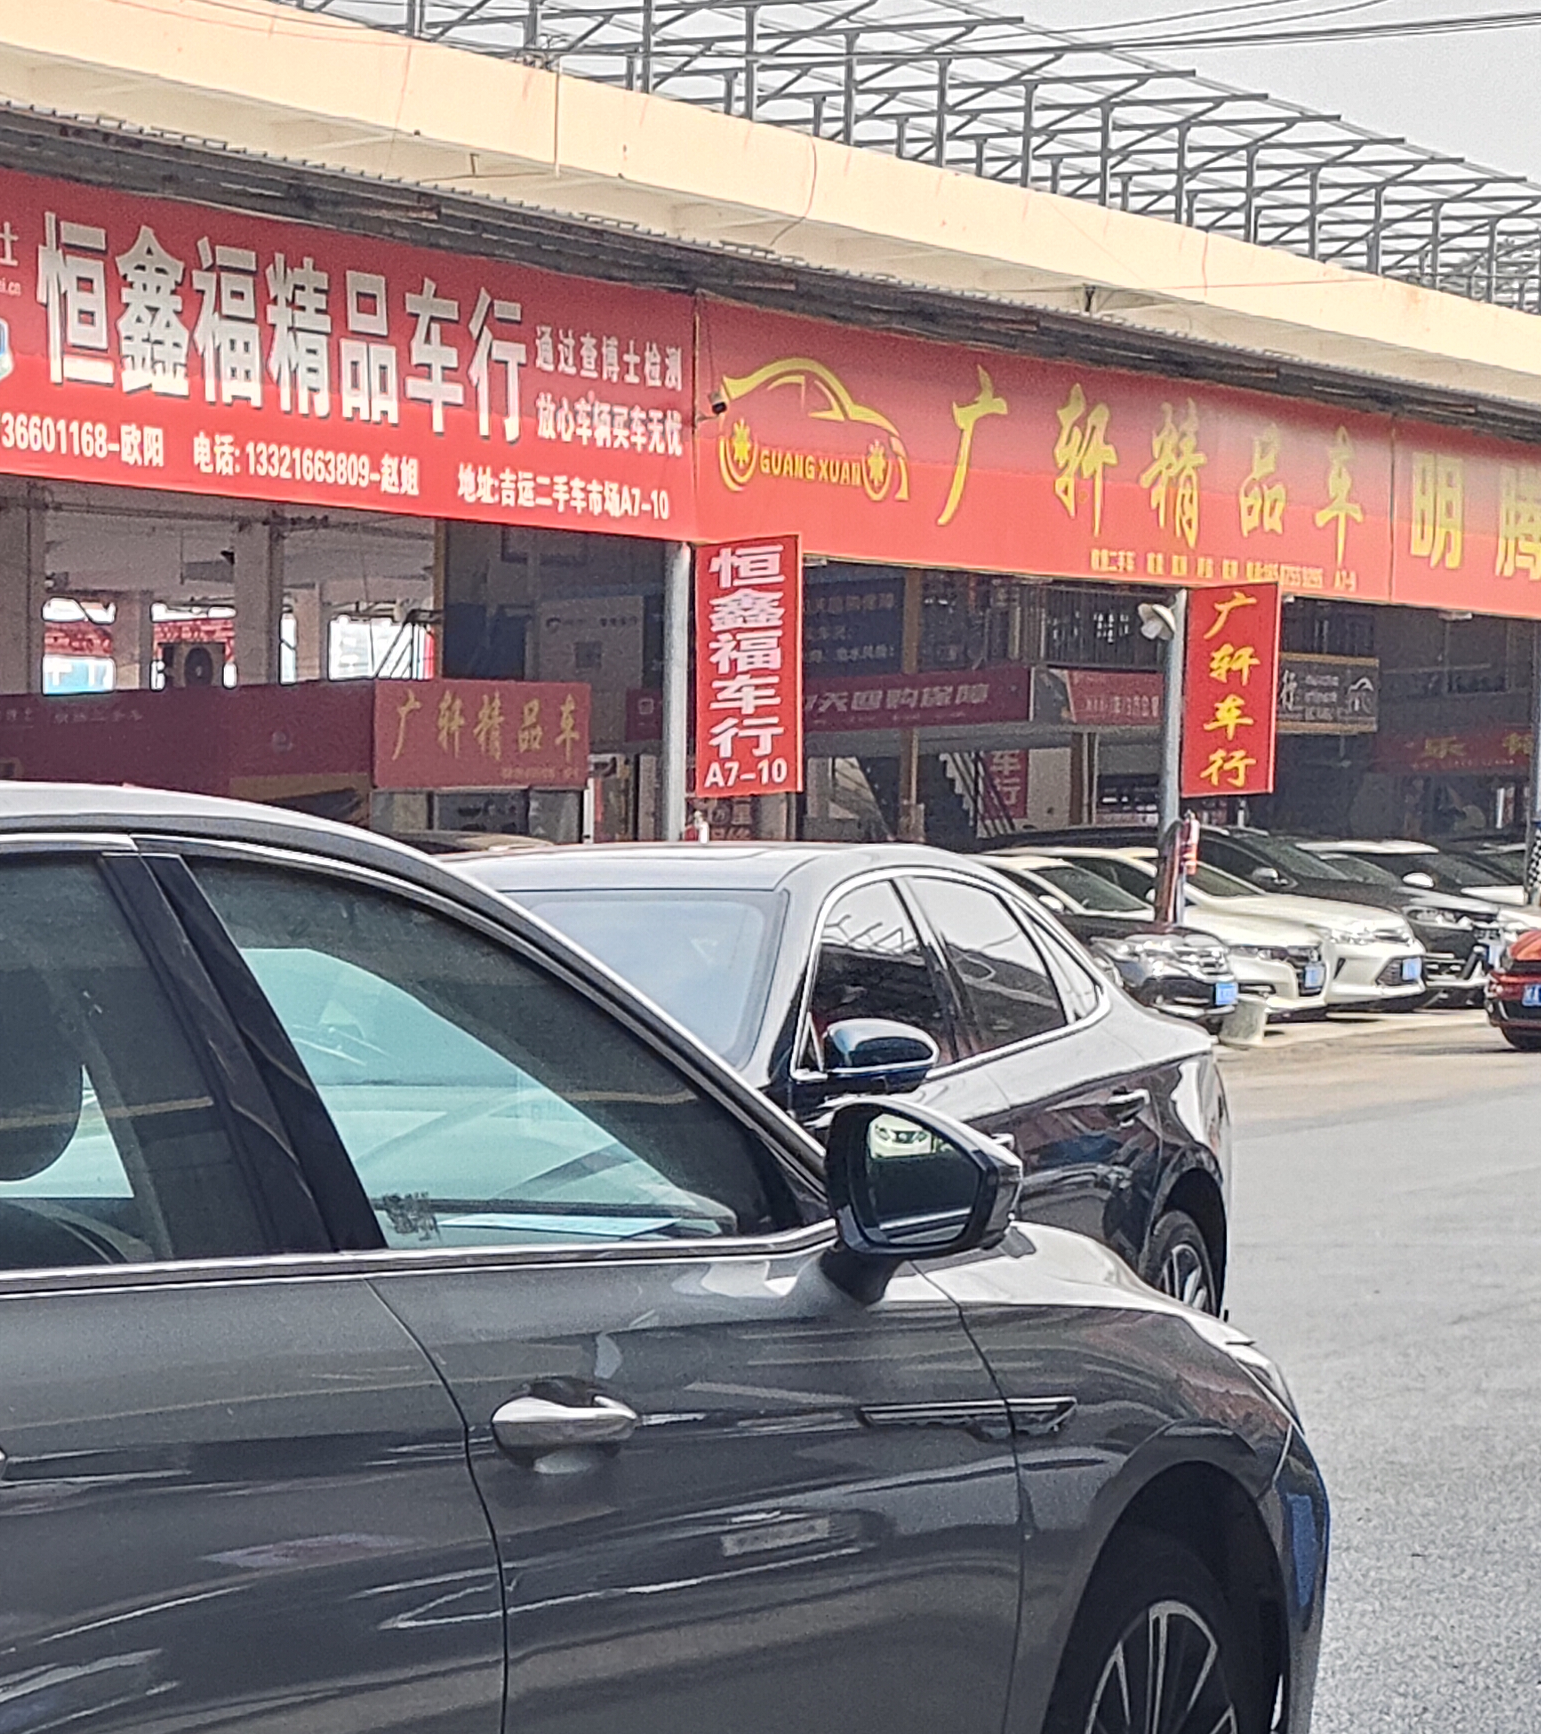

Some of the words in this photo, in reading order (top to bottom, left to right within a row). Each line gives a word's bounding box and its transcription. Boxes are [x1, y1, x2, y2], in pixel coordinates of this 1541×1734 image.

[36, 211, 527, 443] 恒鑫福精品车行
[534, 325, 683, 392] 通过查博士检测
[535, 391, 684, 457] 放心车辆买车无忧
[759, 449, 816, 481] GUANG
[818, 458, 863, 487] XUAN
[936, 364, 1364, 567] 广轩精品车
[707, 544, 786, 759] 恒鑫福车行
[390, 688, 581, 763] 广轩精品车
[1199, 591, 1262, 788] 广轩车行
[704, 757, 788, 788] A7-10
